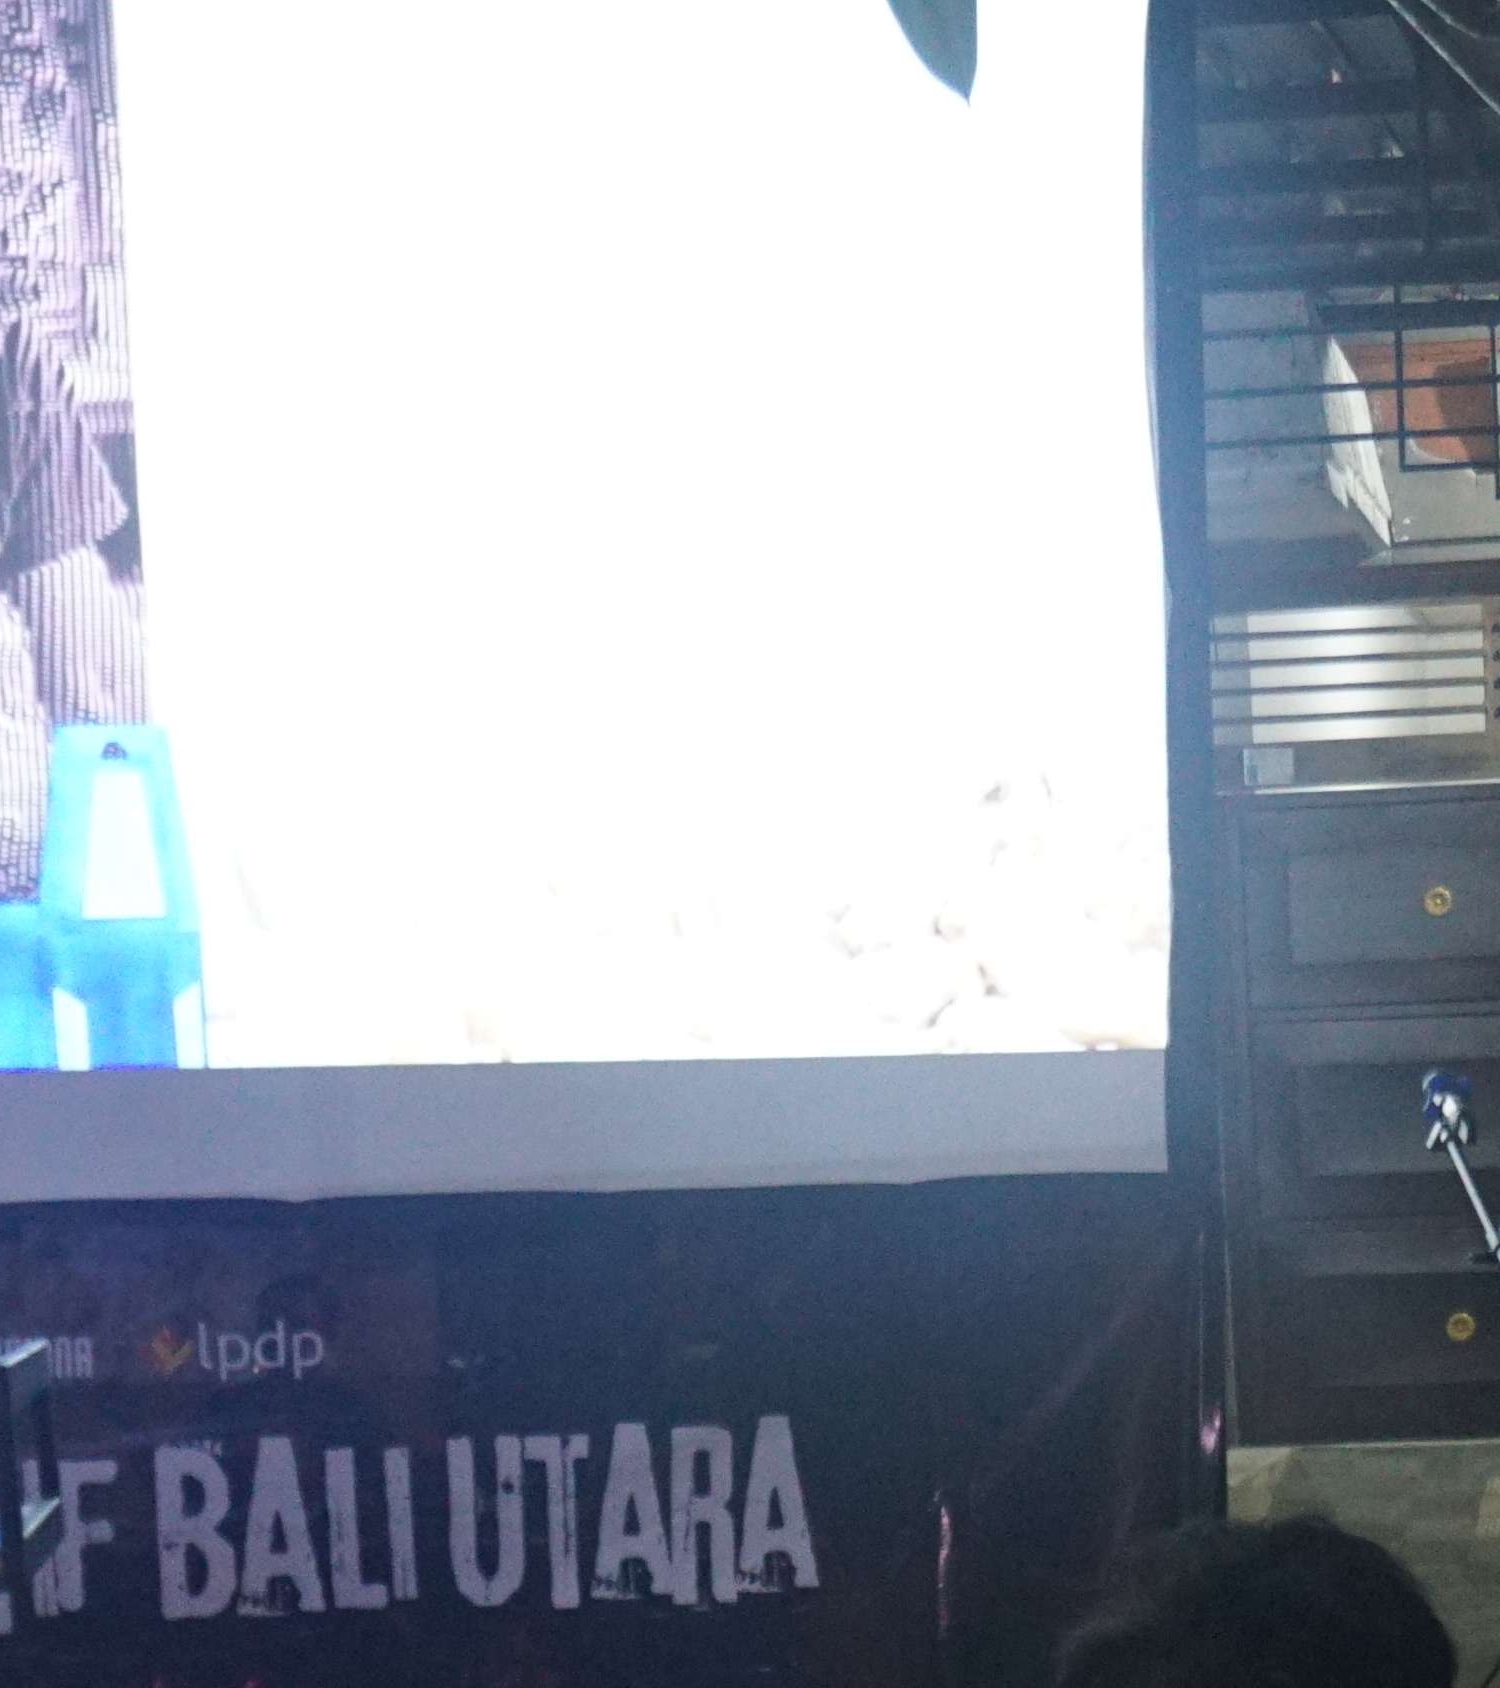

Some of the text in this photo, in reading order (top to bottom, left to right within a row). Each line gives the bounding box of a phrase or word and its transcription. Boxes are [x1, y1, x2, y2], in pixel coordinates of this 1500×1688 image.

[198, 1319, 325, 1382] lpdp
[154, 1430, 423, 1621] BALI
[446, 1414, 821, 1611] UTARA
